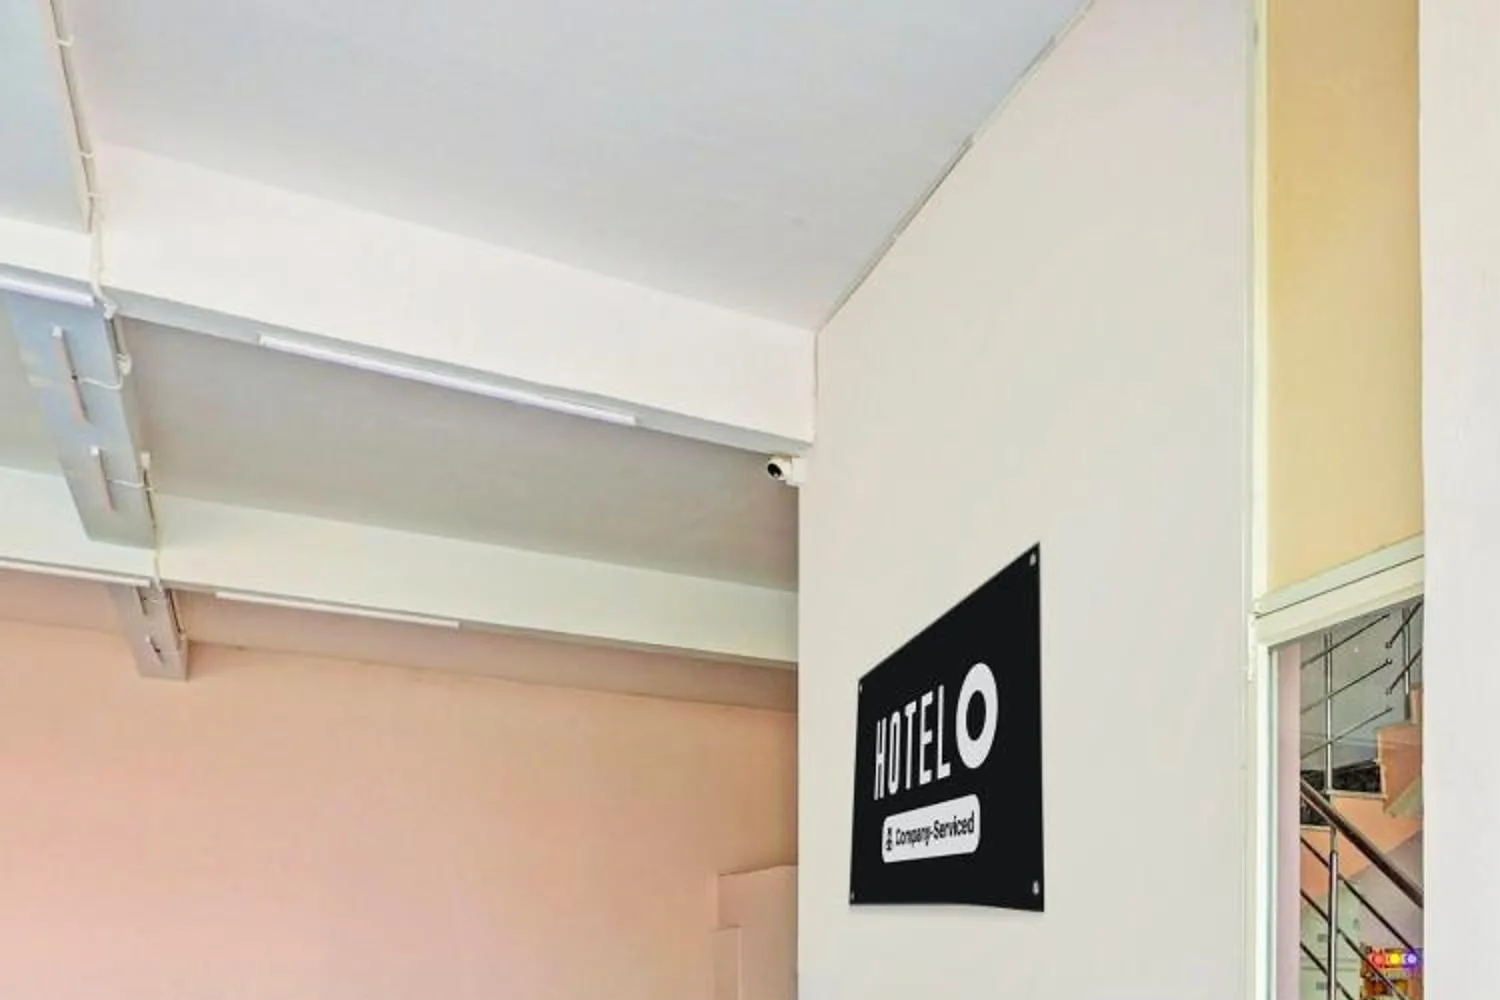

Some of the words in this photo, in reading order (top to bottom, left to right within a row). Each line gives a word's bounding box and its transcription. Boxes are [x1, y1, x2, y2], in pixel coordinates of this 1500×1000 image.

[874, 685, 951, 801] HOTEL
[956, 662, 999, 769] O
[895, 810, 975, 847] Company-Serviced
